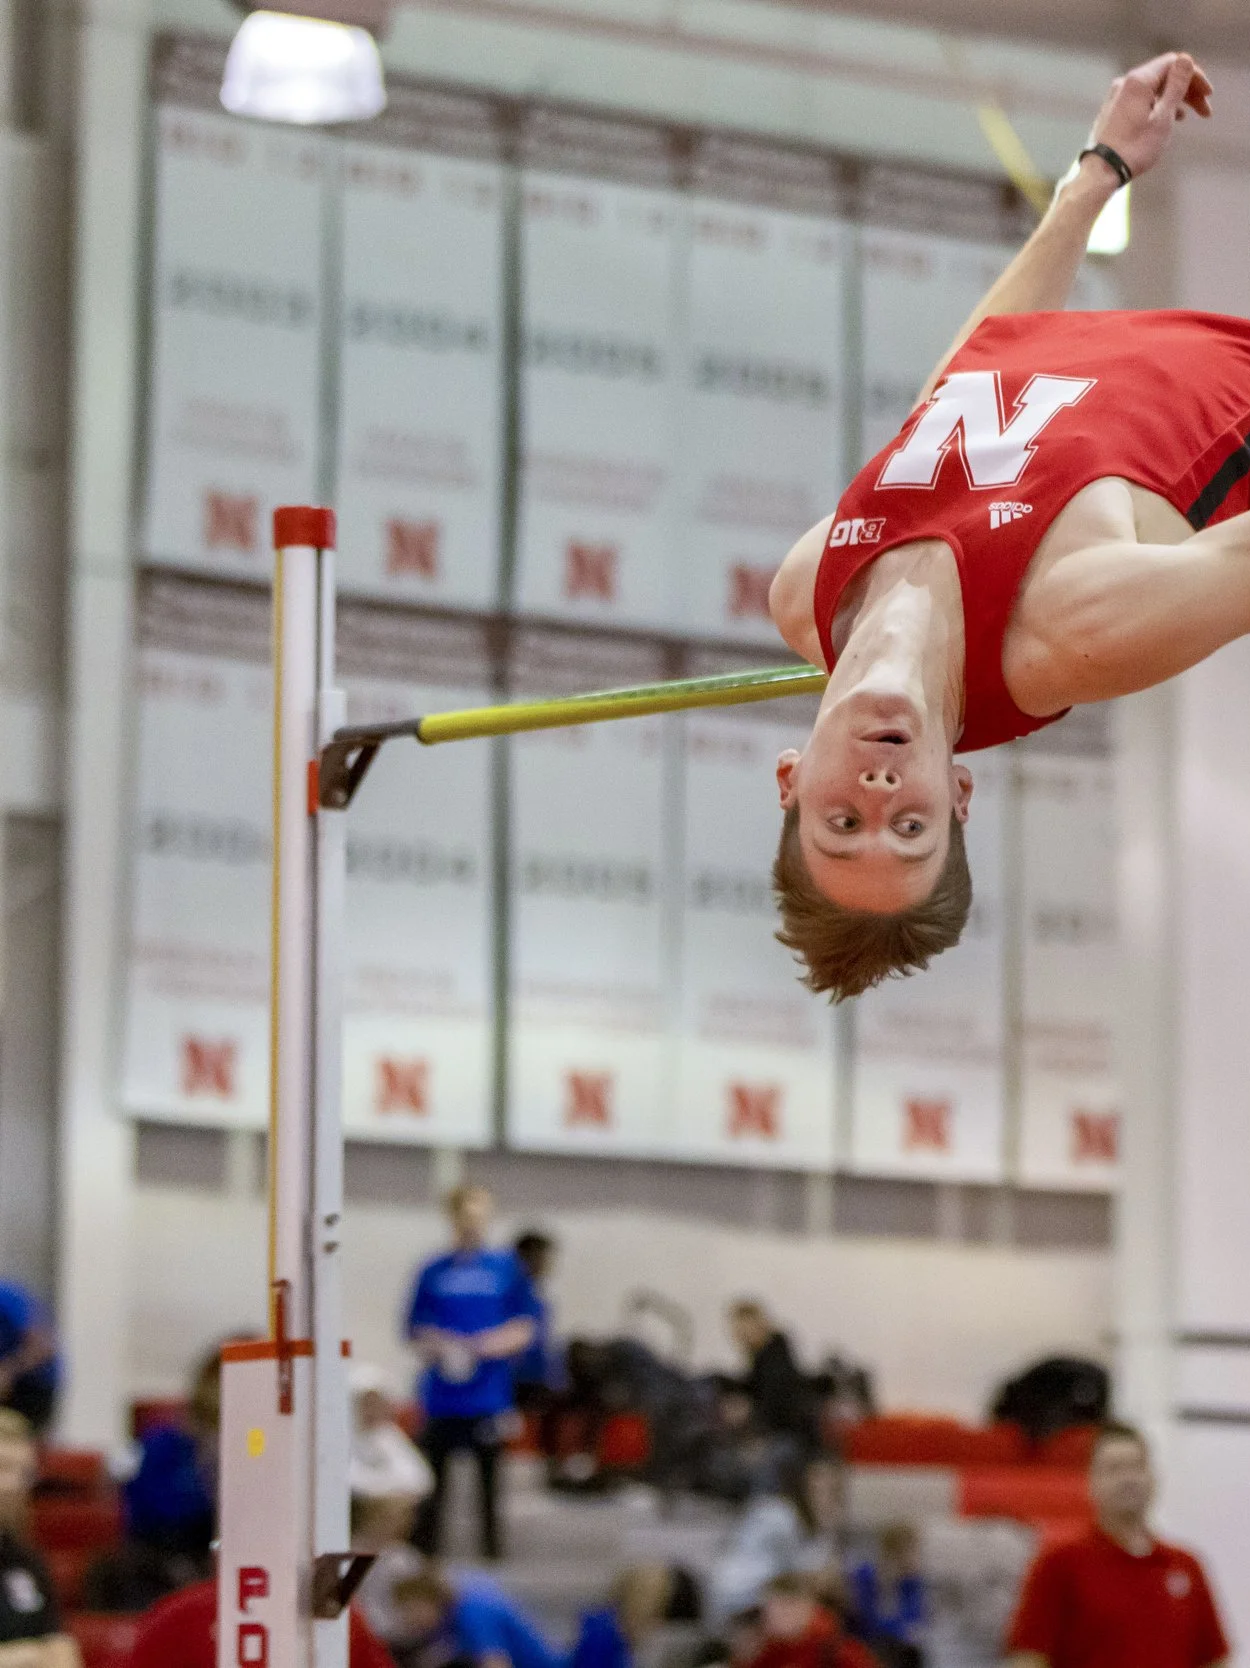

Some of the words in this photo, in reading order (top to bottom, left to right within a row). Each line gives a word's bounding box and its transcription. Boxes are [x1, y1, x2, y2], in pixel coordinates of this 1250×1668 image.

[874, 370, 1098, 491] N
[205, 490, 258, 552] N
[988, 501, 1033, 514] adidas
[384, 517, 440, 579] N
[565, 541, 618, 602] N
[180, 1034, 238, 1101] N
[376, 1055, 430, 1117] N
[564, 1068, 614, 1129] N
[728, 1081, 782, 1141] N
[903, 1098, 952, 1152] N
[1070, 1110, 1119, 1164] N
